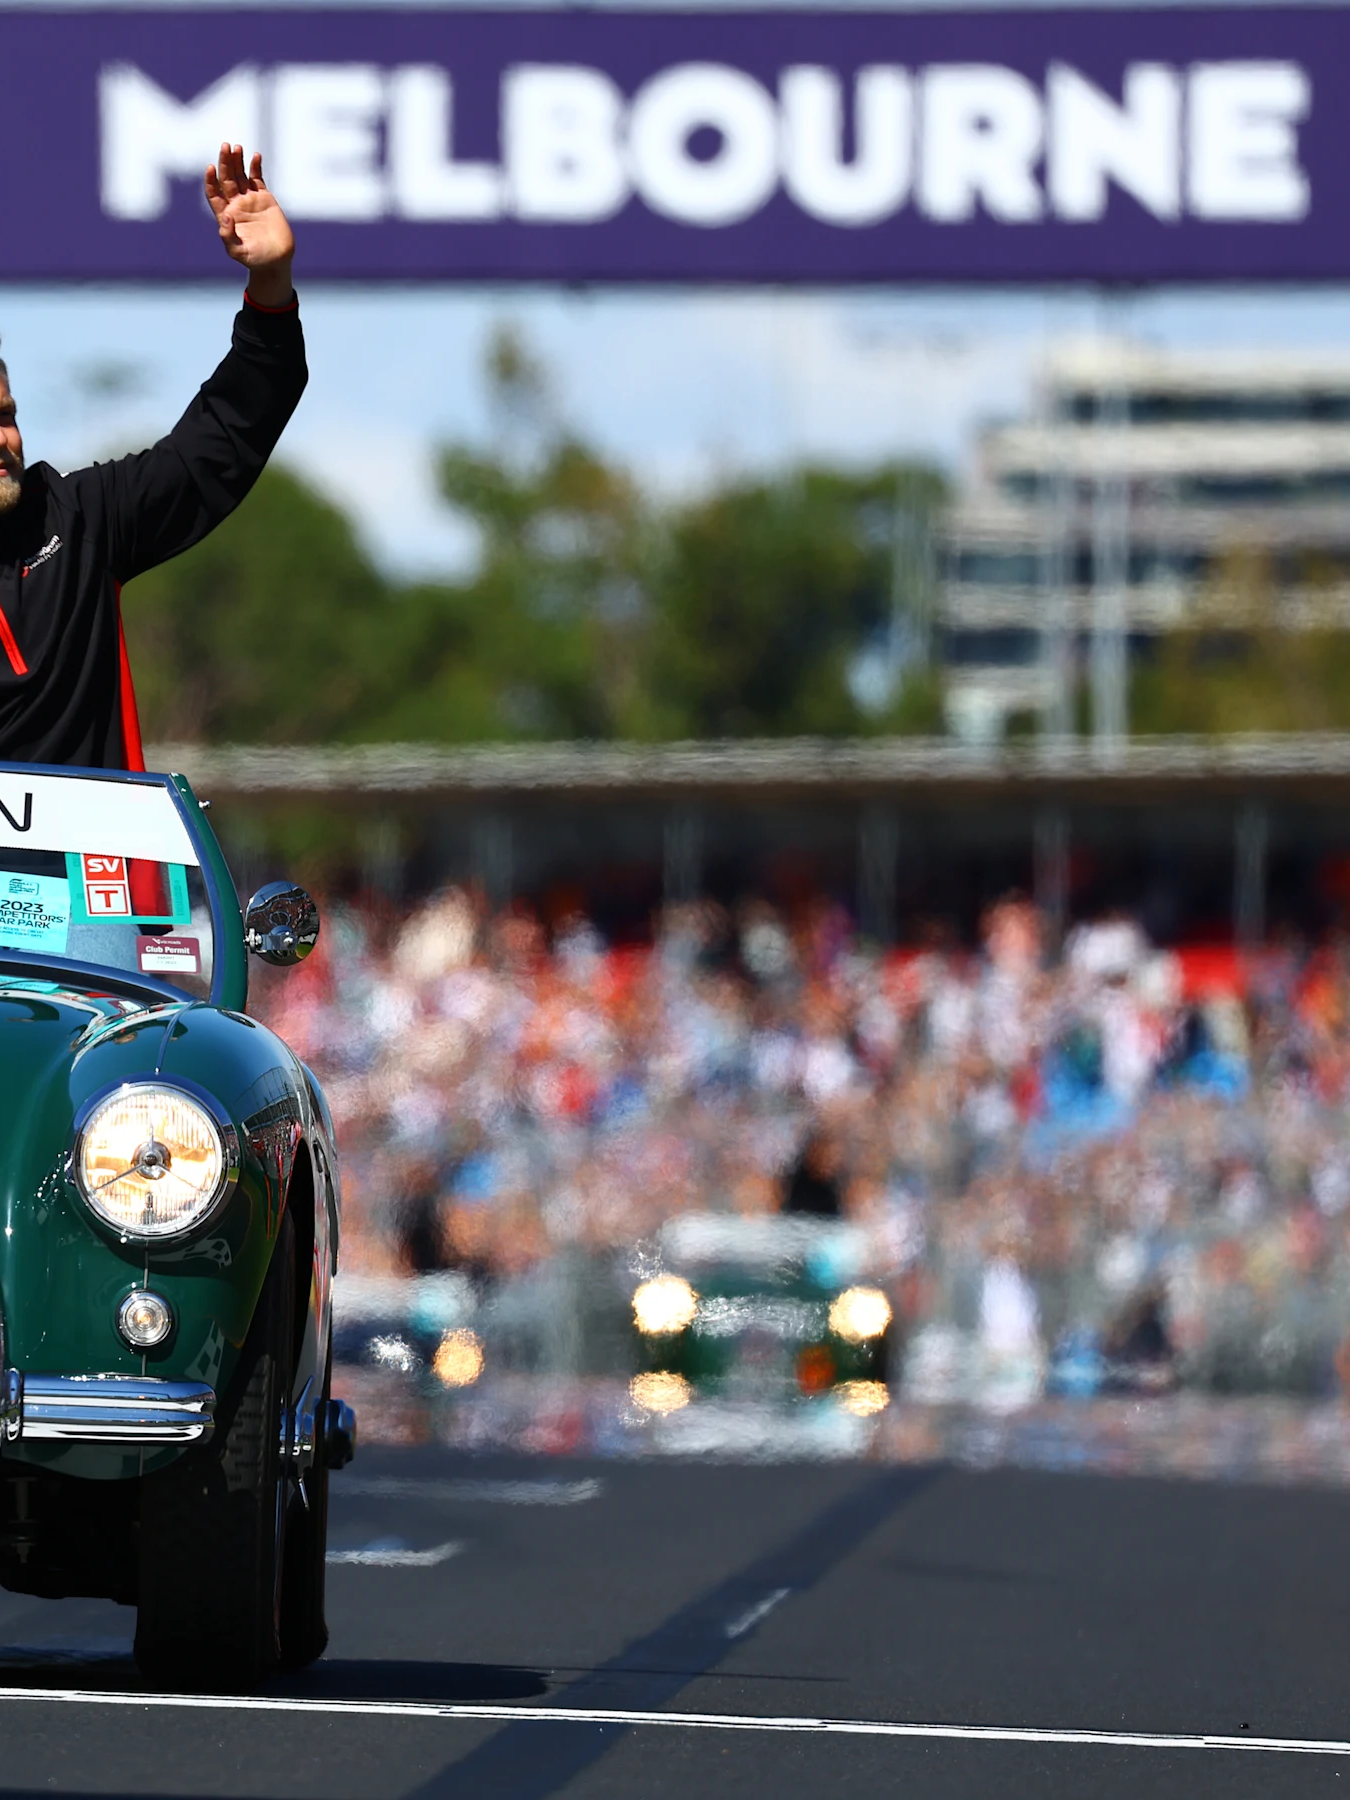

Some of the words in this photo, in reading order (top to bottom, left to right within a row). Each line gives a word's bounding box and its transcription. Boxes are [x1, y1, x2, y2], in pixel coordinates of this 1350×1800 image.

[100, 62, 1310, 226] MELBOURNE
[87, 858, 120, 873] SV
[0, 899, 44, 913] 2023
[95, 890, 118, 908] T
[17, 919, 50, 929] PARK
